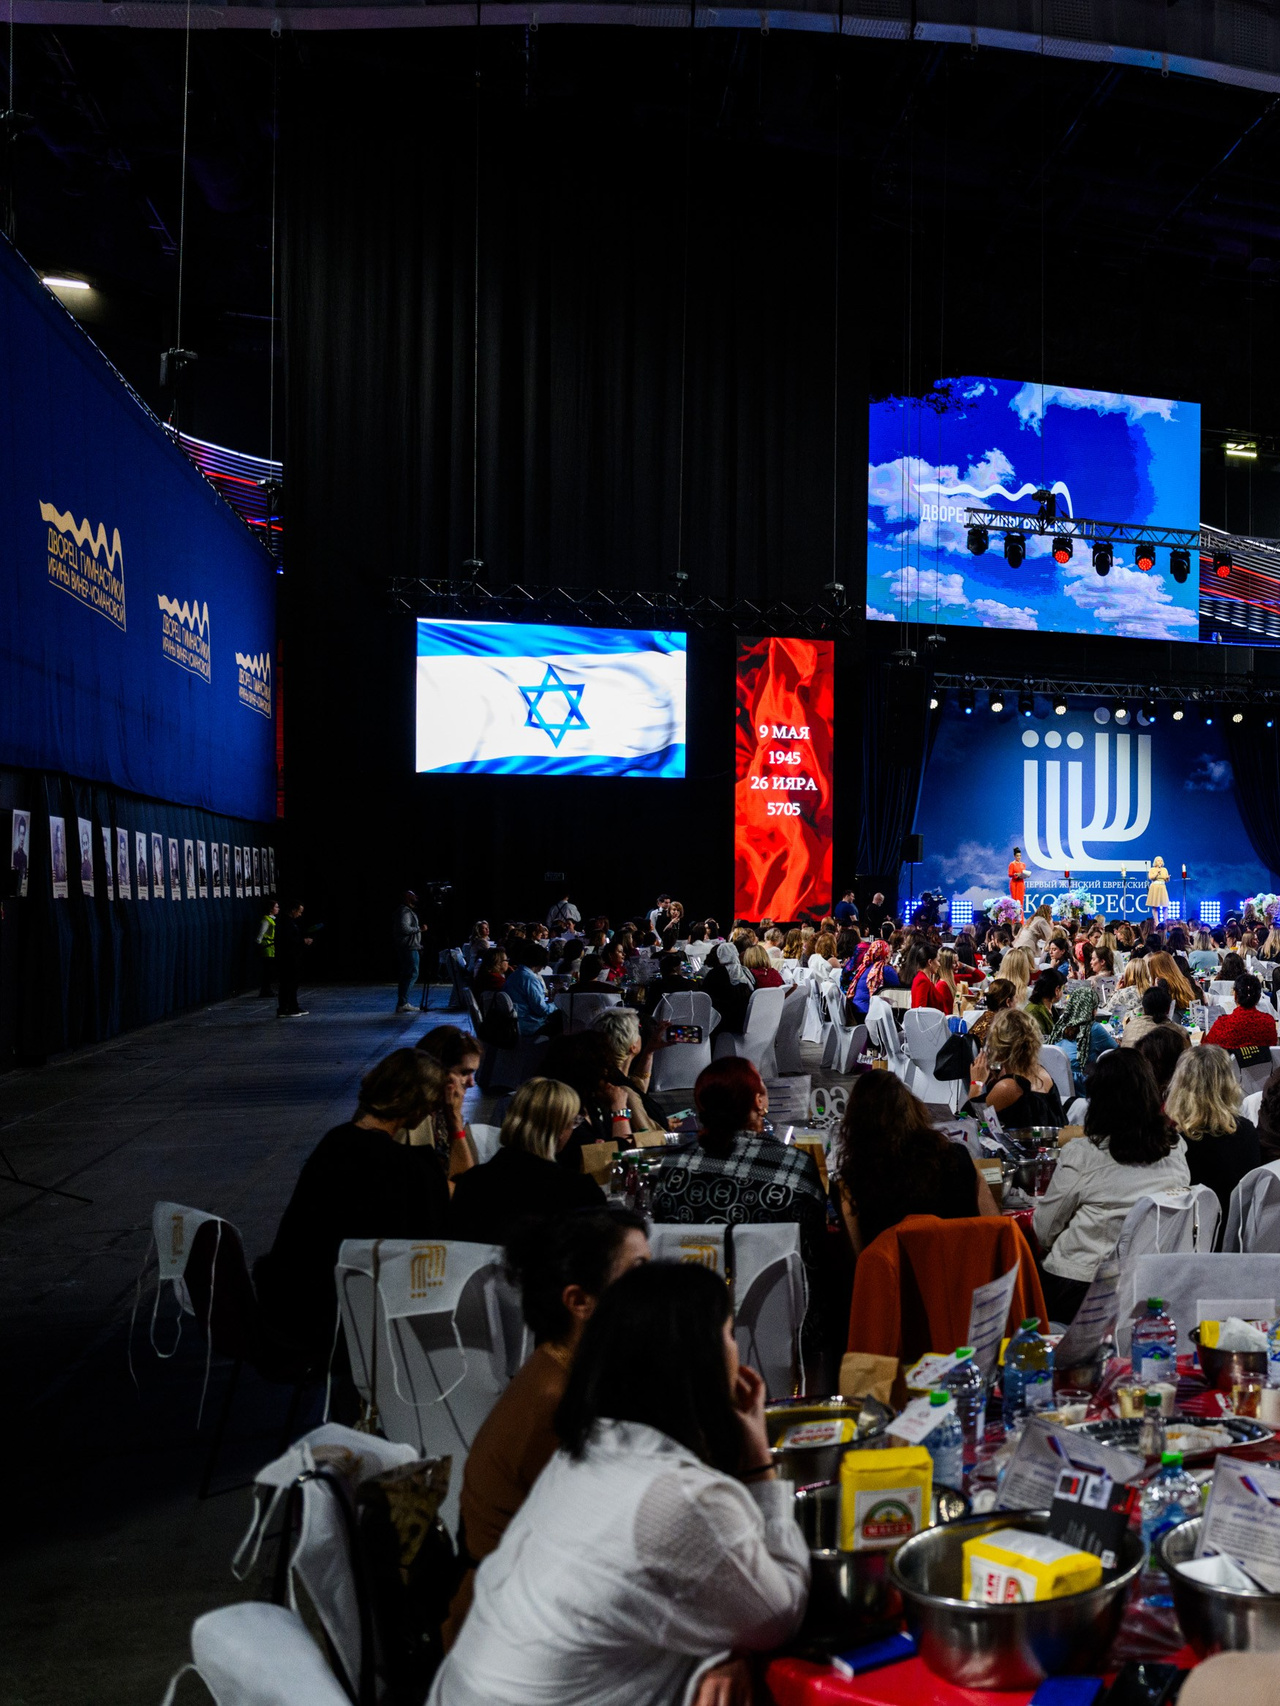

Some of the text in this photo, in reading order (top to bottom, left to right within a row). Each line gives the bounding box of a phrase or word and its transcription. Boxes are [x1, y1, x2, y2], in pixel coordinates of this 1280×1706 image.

[48, 527, 124, 602] ДВОРЕЦ ГИМНАСТИКИ
[48, 554, 124, 623] ИРИНЫ ВИНЕР-УСМАНОВОЙ
[759, 724, 810, 739] 9 МАЯ
[769, 750, 802, 765] 1945
[750, 775, 818, 791] 26 ИЯРА
[767, 802, 802, 816] 5705
[1024, 880, 1057, 889] ПЕРВЫЙ
[1059, 880, 1101, 889] ЖНСКИЙ
[1024, 893, 1150, 915] КОРЕСС
